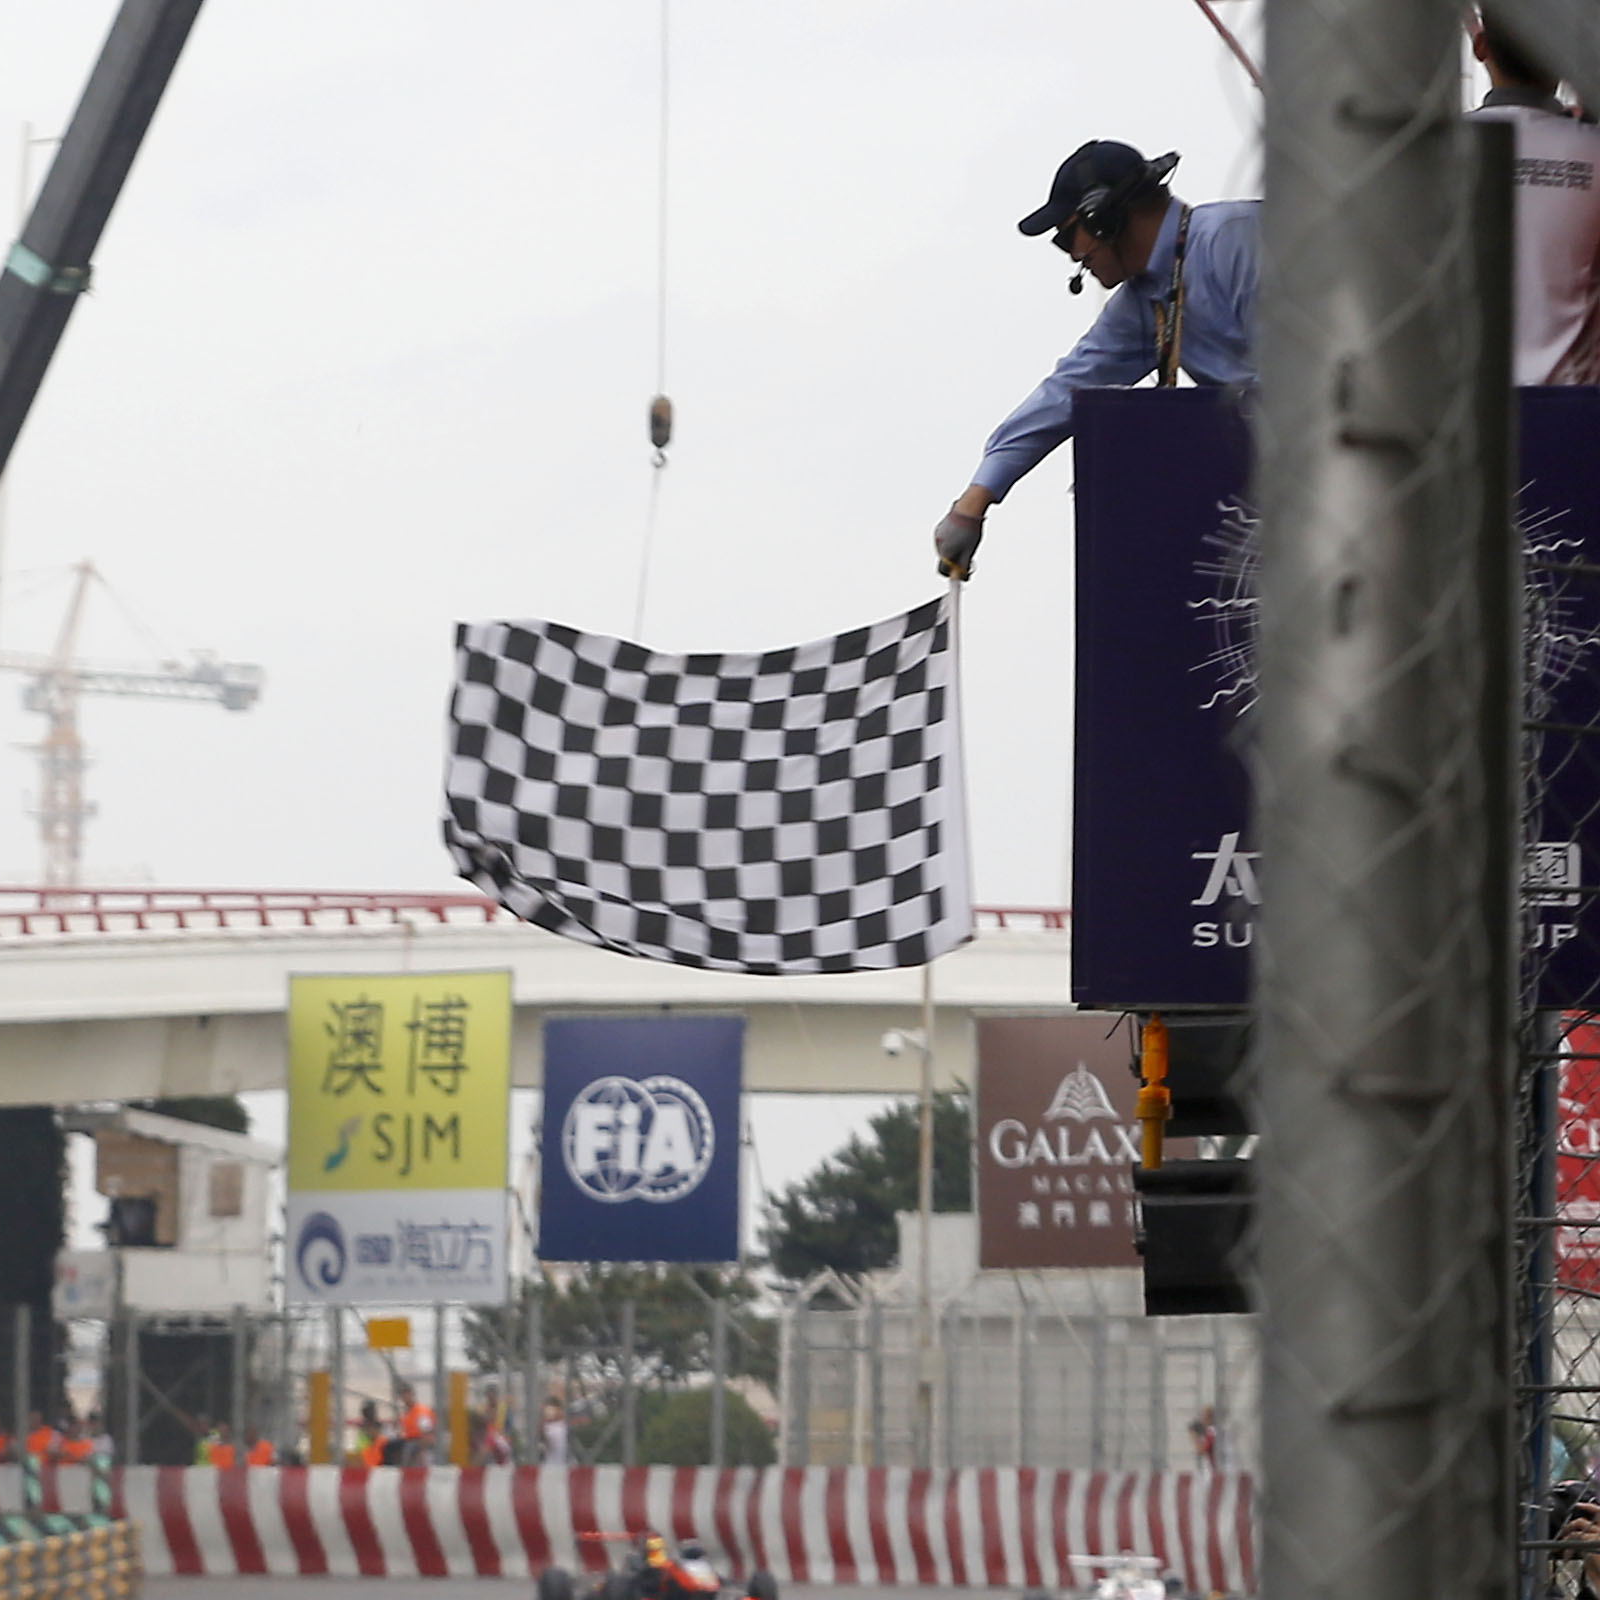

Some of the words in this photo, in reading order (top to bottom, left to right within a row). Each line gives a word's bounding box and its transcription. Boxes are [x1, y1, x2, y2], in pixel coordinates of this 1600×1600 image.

[321, 995, 471, 1097] 澳博
[372, 1111, 461, 1177] SJM
[989, 1118, 1150, 1168] GALAX
